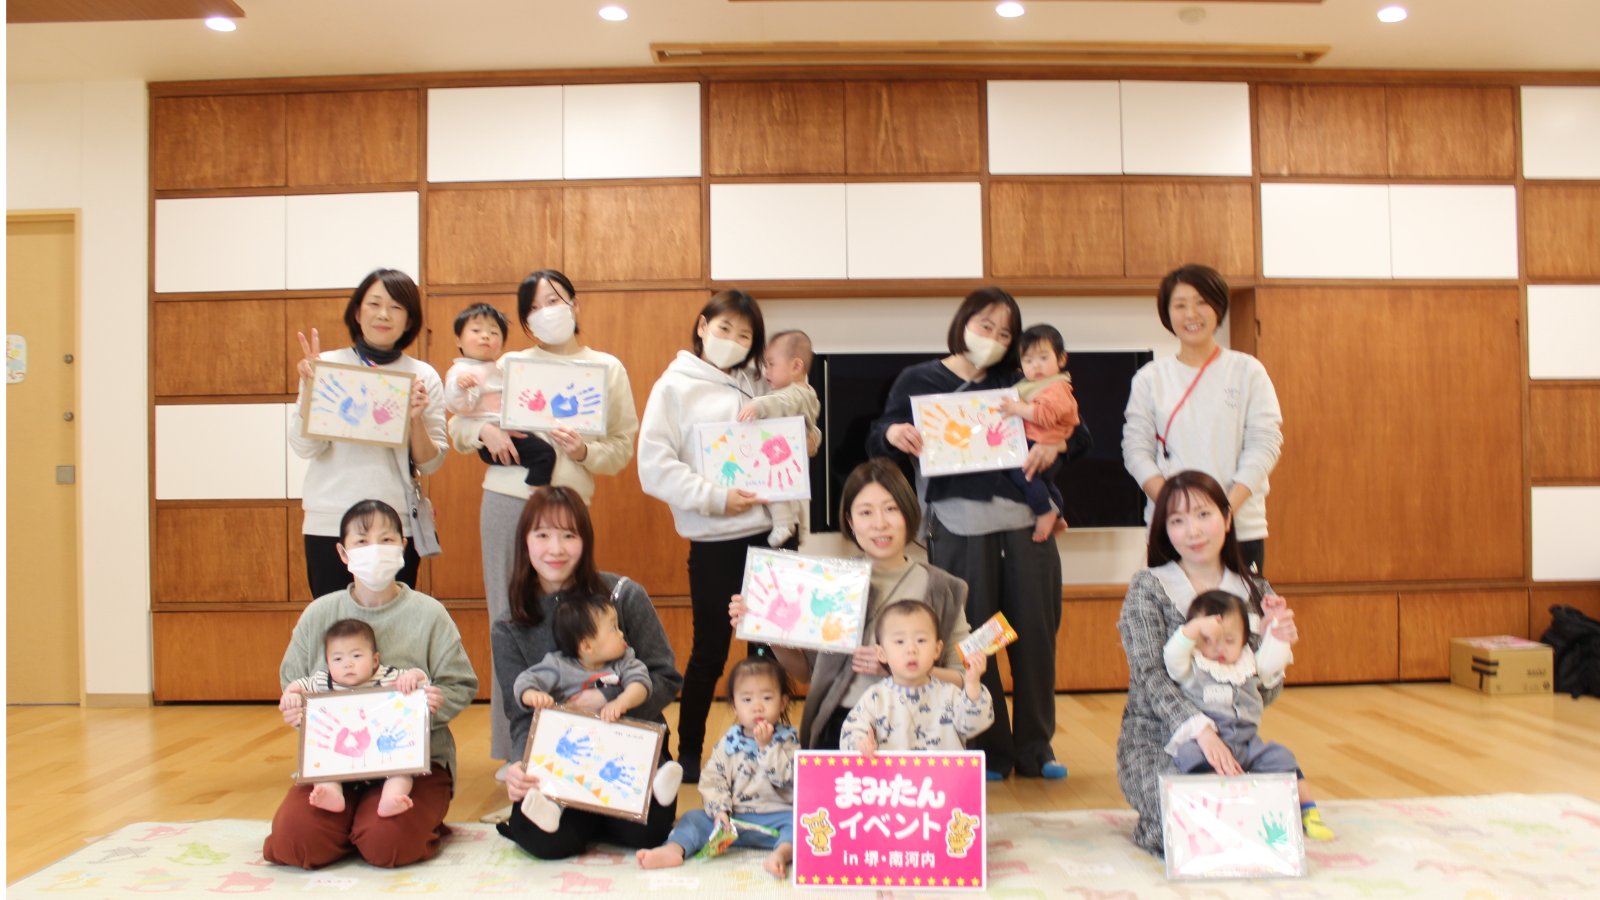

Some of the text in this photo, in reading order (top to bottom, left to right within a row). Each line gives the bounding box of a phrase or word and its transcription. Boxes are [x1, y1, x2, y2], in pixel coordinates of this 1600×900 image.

[835, 771, 946, 808] まみたん
[839, 812, 941, 840] イベント
[843, 850, 859, 866] in
